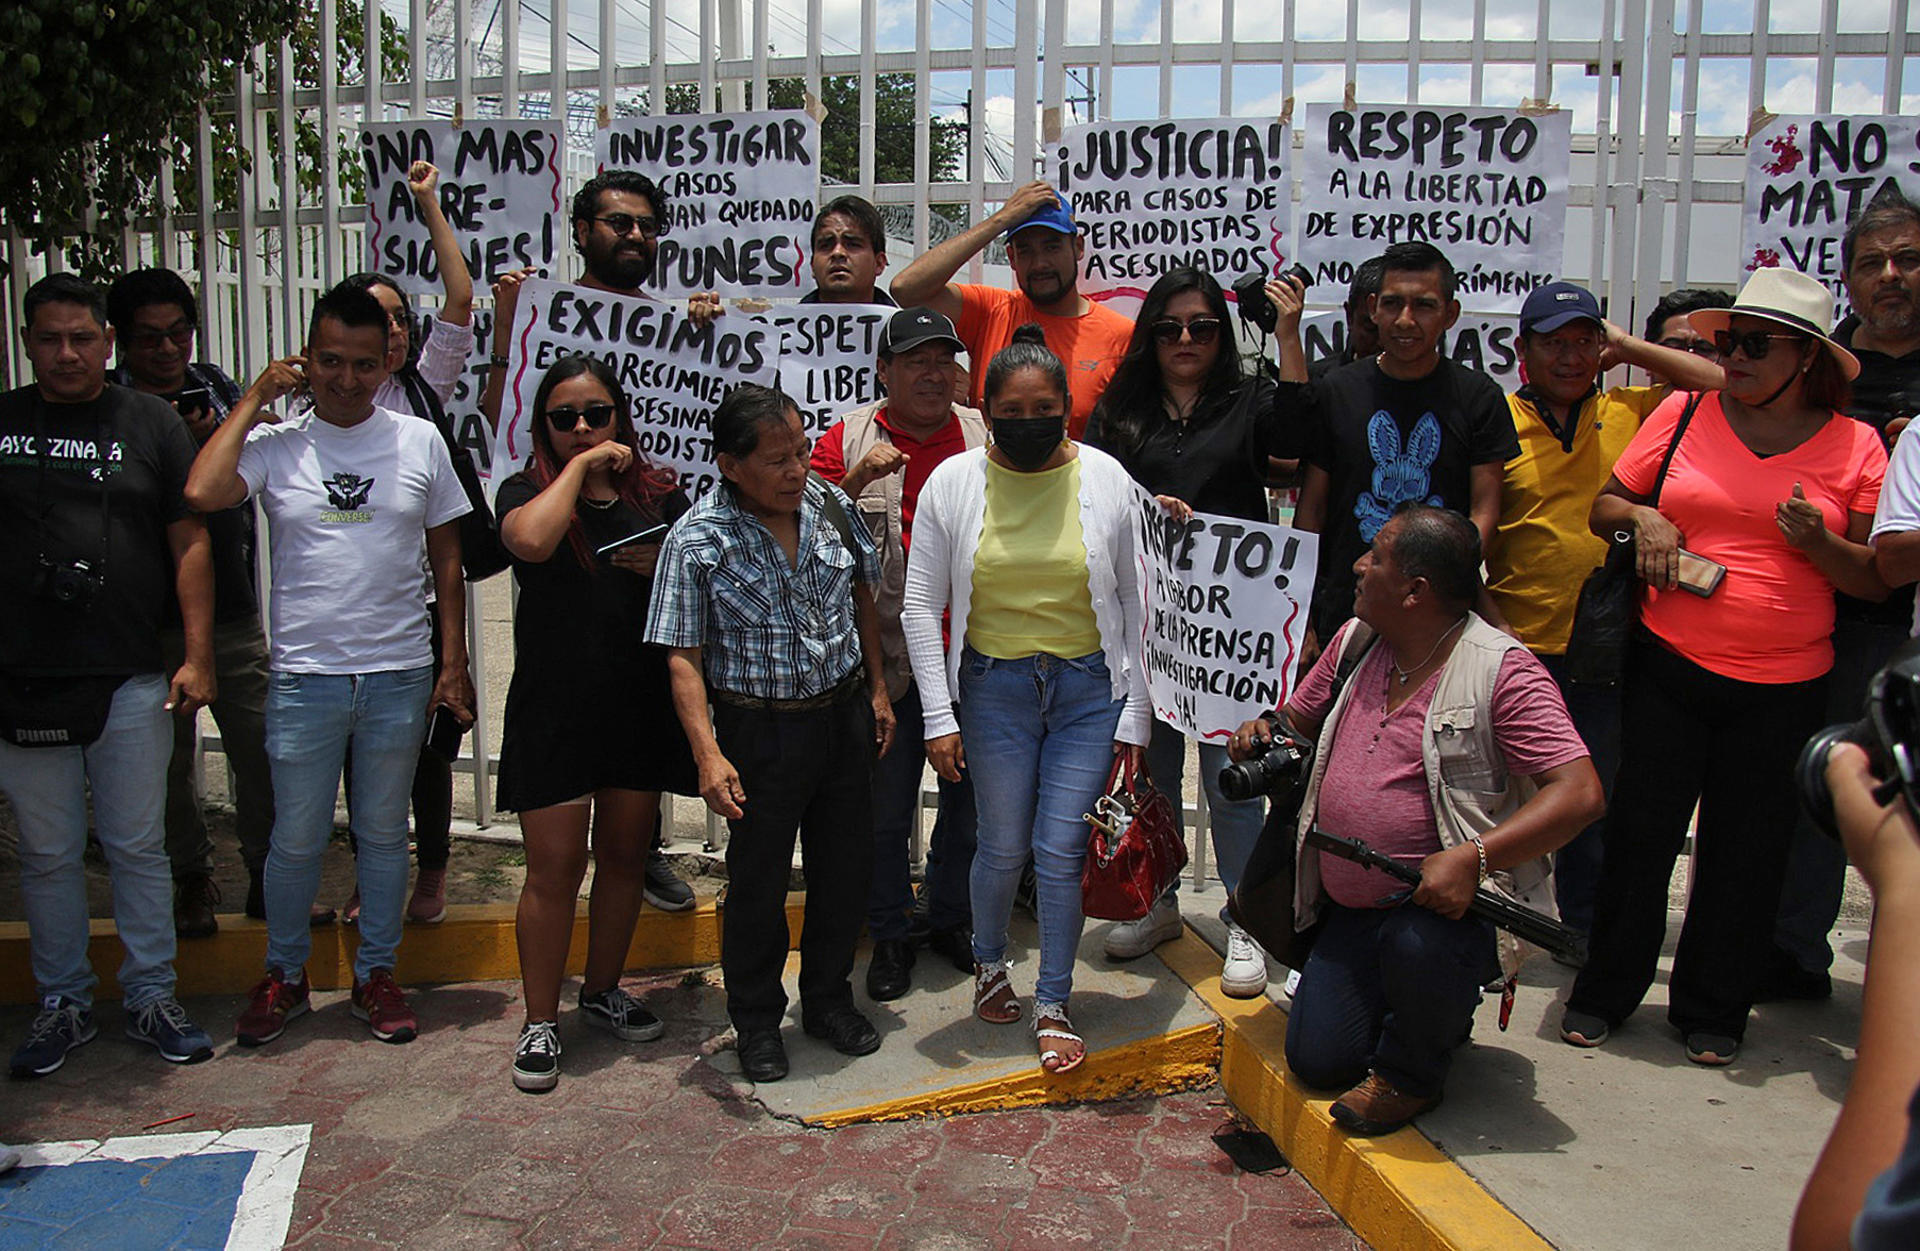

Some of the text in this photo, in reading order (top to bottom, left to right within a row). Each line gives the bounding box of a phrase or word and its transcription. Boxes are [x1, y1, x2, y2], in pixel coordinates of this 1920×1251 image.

[454, 127, 545, 178] MAS
[609, 118, 811, 168] INVESTIGAR
[1057, 122, 1282, 192] ¡JUSTICIA!
[1327, 110, 1538, 169] RESPETO
[1809, 119, 1888, 178] NO
[660, 171, 737, 199] CASOS
[1072, 186, 1277, 214] PARA CASOS DE
[1329, 168, 1547, 207] A LA LIBERTAD
[718, 198, 814, 228] QUEDADO
[1306, 208, 1533, 246] DE EXPRESIÓN
[648, 236, 793, 291] PUNES
[1085, 246, 1270, 280] ASESINADOS
[1316, 261, 1354, 287] NO
[1156, 567, 1232, 619] A LABOR
[1155, 608, 1276, 669] DE LA PRENSA
[1146, 640, 1279, 706] ¡INVESTIGACIÓN
[1175, 691, 1197, 731] YA!
[16, 729, 69, 742] PUMA
